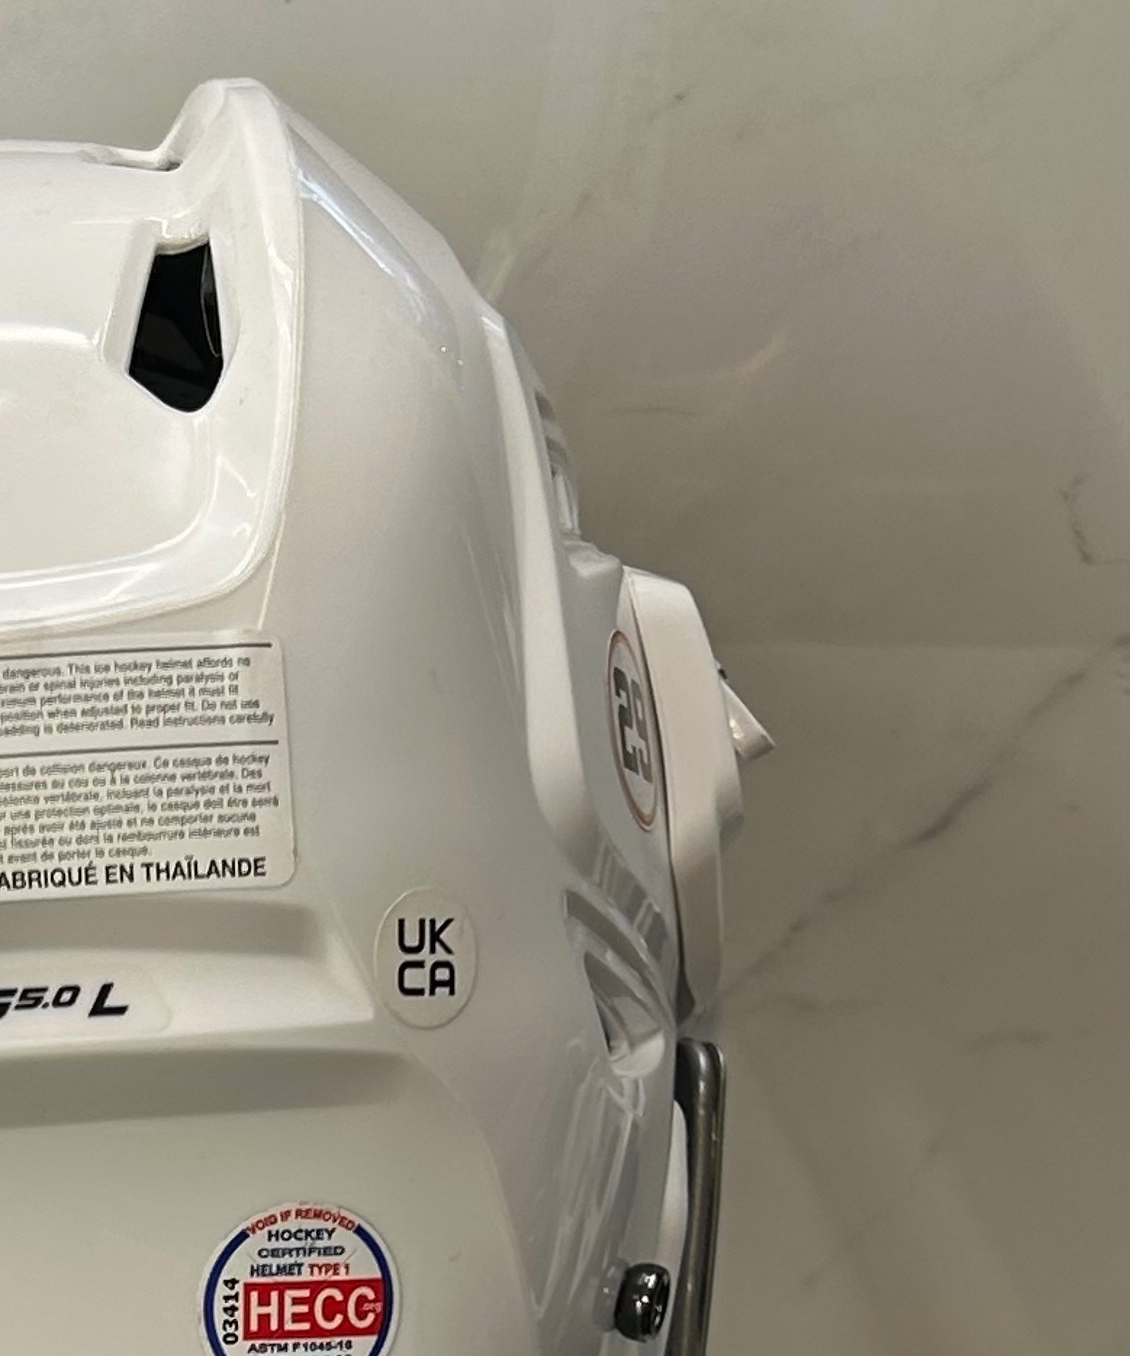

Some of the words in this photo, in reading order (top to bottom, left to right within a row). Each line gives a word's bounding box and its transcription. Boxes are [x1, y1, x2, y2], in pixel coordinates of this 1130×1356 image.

[613, 666, 653, 784] 29
[105, 862, 135, 885] EN
[141, 853, 267, 884] THAÏLANDE
[397, 917, 455, 955] UK
[397, 960, 456, 997] CA
[87, 982, 129, 1018] L
[246, 1214, 278, 1235] VOID
[280, 1210, 291, 1222] IF
[294, 1208, 356, 1231] REMOVED
[267, 1228, 336, 1242] HOCKEY
[257, 1246, 346, 1258] CERTIFIED
[250, 1262, 304, 1277] HELMET
[308, 1263, 341, 1276] TYPE
[344, 1263, 350, 1275] 1
[222, 1277, 240, 1345] 03414
[249, 1286, 376, 1332] HECC
[247, 1342, 288, 1354] ASTM
